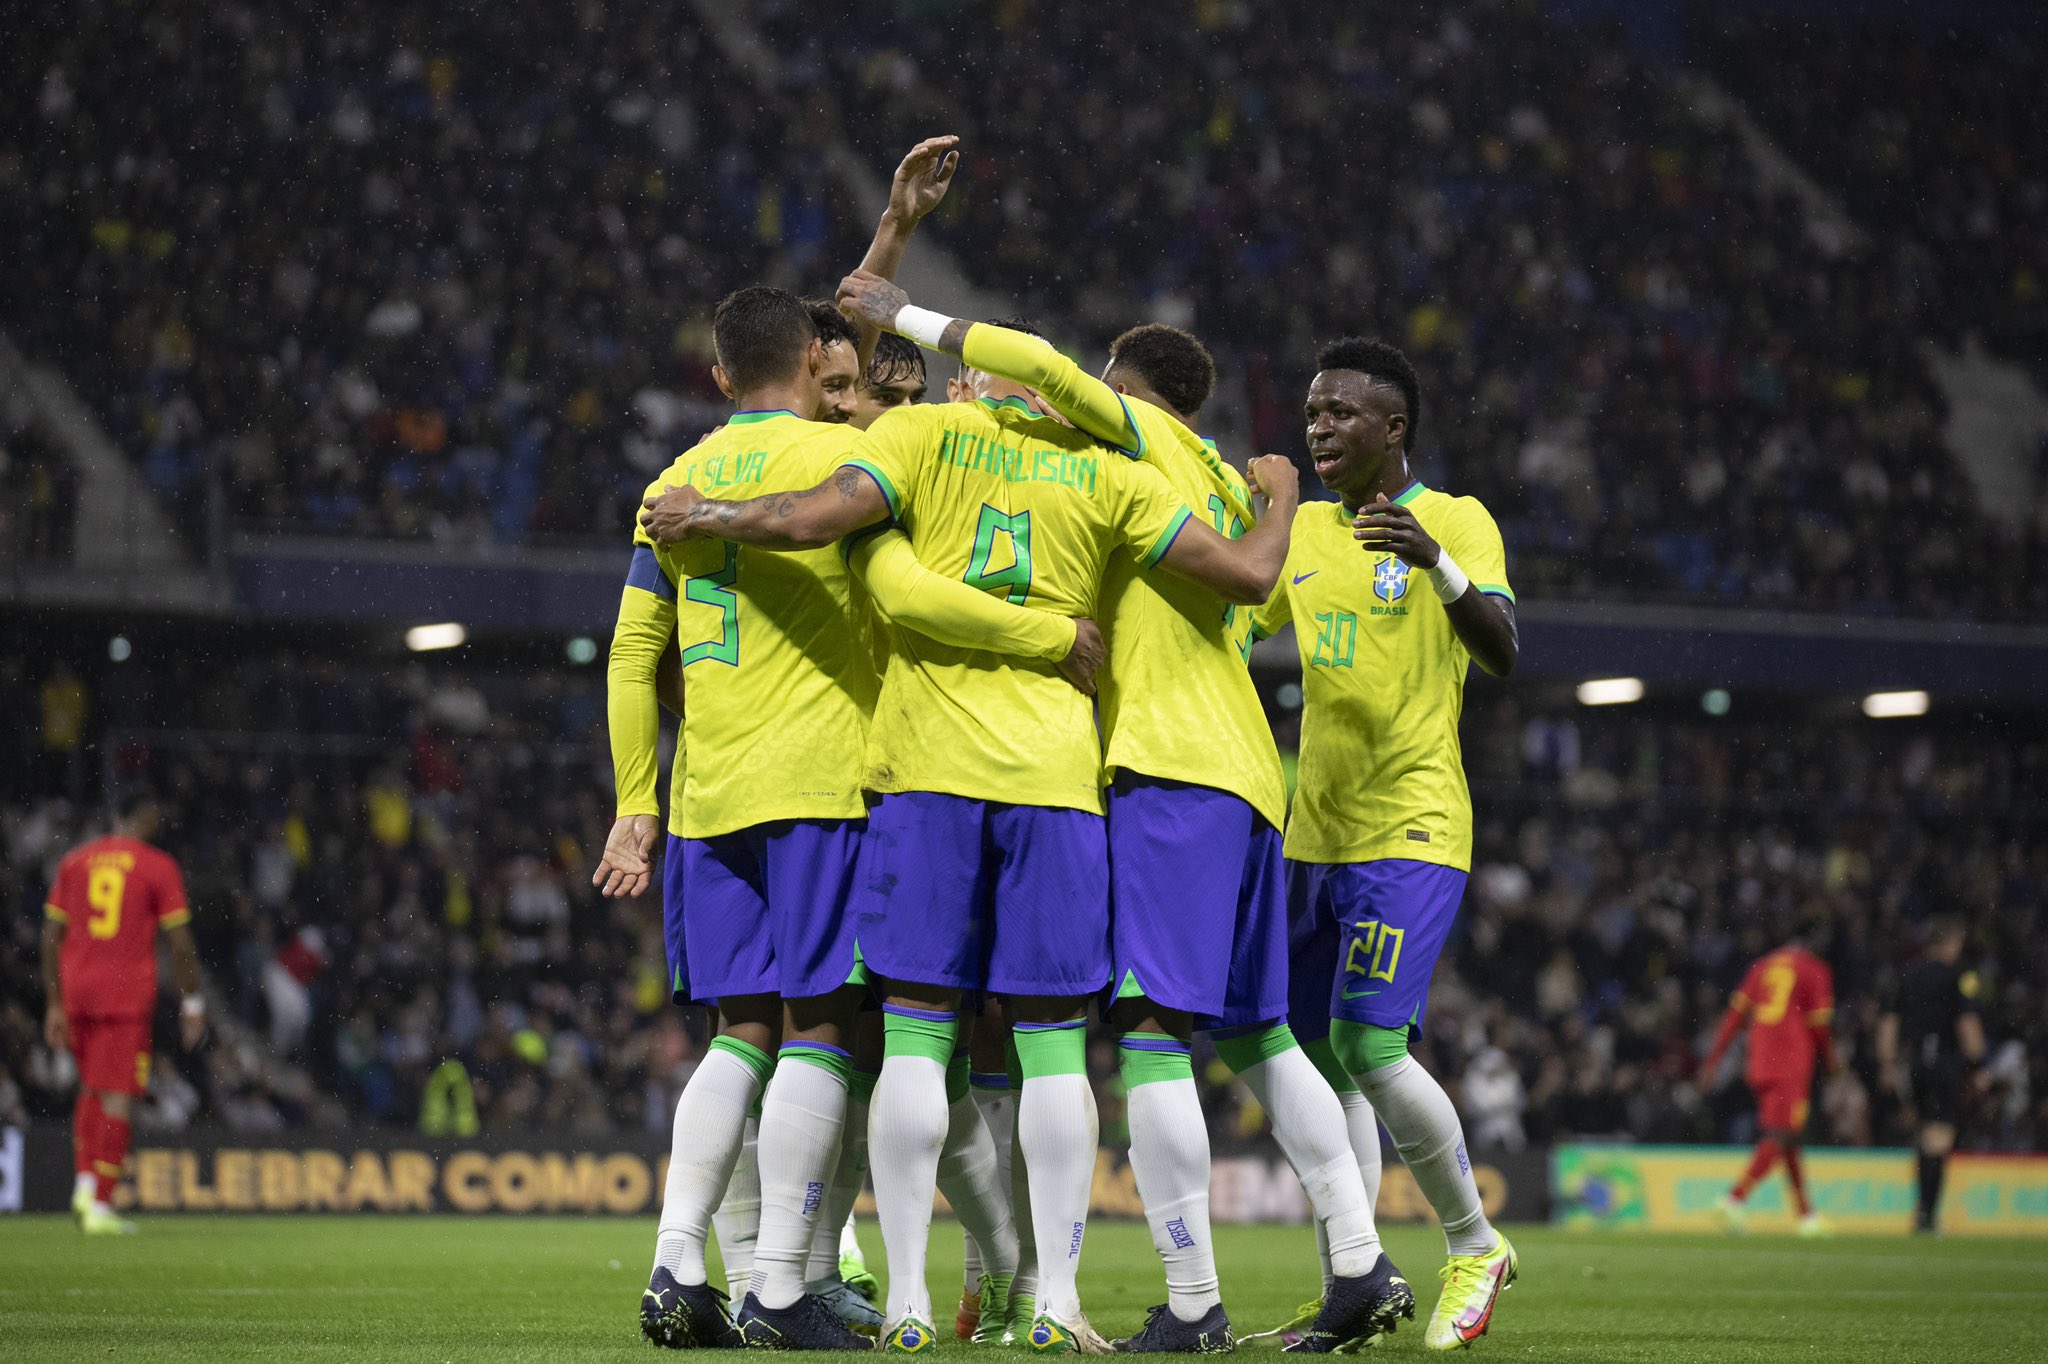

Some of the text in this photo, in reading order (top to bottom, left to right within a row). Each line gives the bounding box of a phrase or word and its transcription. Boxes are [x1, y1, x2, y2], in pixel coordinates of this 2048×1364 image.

[963, 502, 1032, 606] 9
[682, 541, 739, 668] 3
[1371, 606, 1409, 616] BRASIL
[1311, 612, 1357, 668] 20
[88, 865, 125, 939] 9
[1345, 920, 1405, 985] 20
[1757, 967, 1796, 1024] 3
[445, 1151, 653, 1211] COMO
[802, 1181, 824, 1215] BRASIL
[1069, 1221, 1084, 1259] BRASIL
[1165, 1215, 1195, 1249] BRASIL
